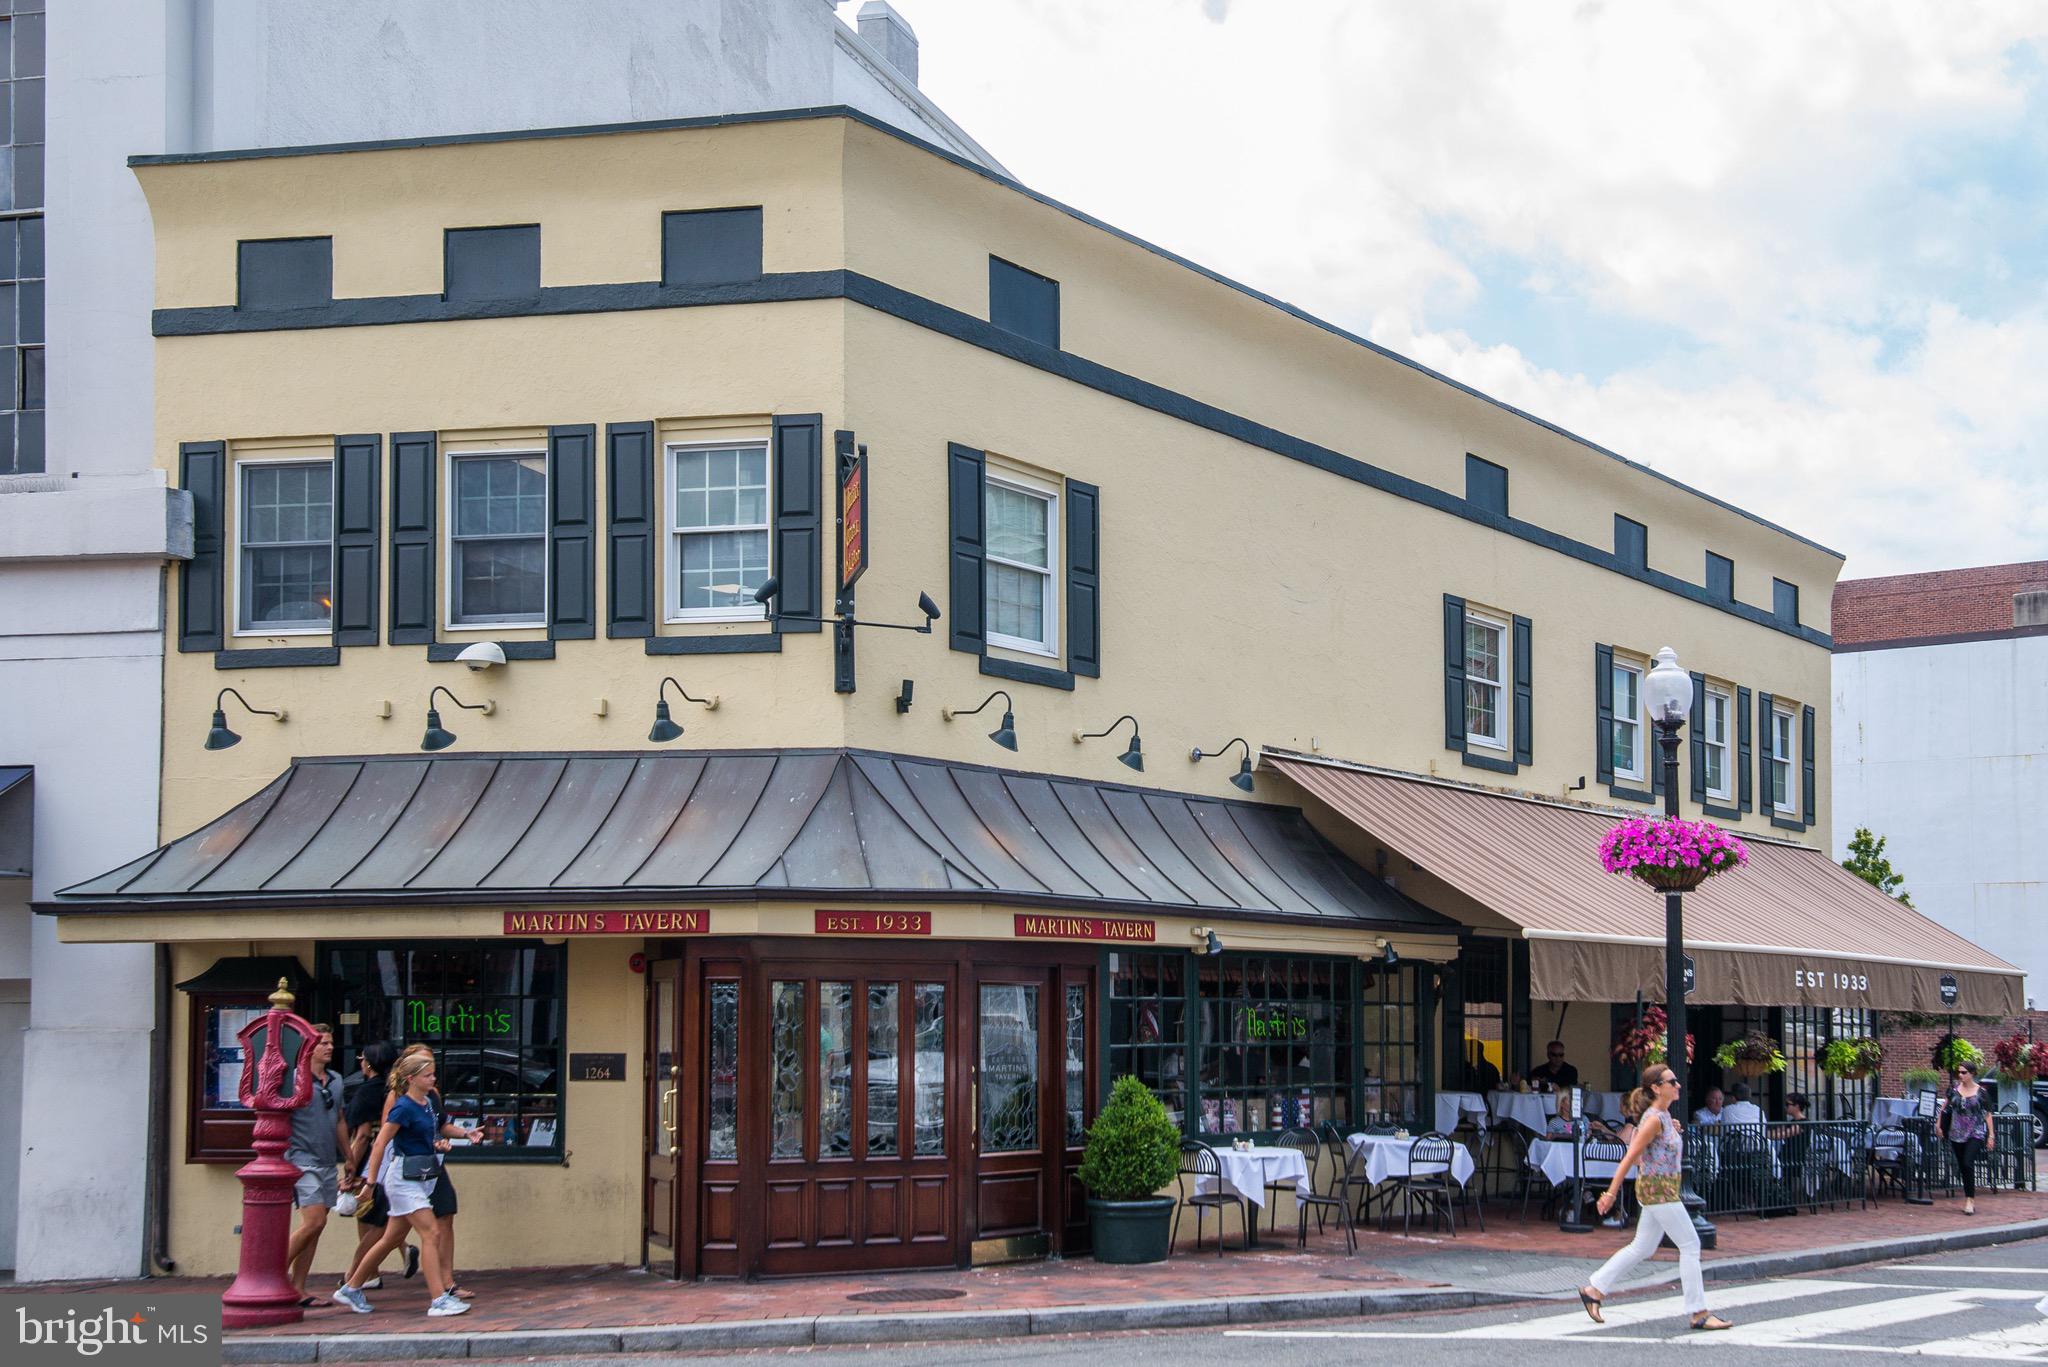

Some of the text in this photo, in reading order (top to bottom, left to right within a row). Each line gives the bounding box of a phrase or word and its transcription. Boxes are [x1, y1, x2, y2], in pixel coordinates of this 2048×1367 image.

[622, 913, 698, 930] TAVERN
[827, 915, 922, 931] EST. 1933
[1025, 918, 1152, 938] MARTIN'S TAVERN
[1795, 970, 1868, 991] EST 1933
[585, 1066, 610, 1079] 1264
